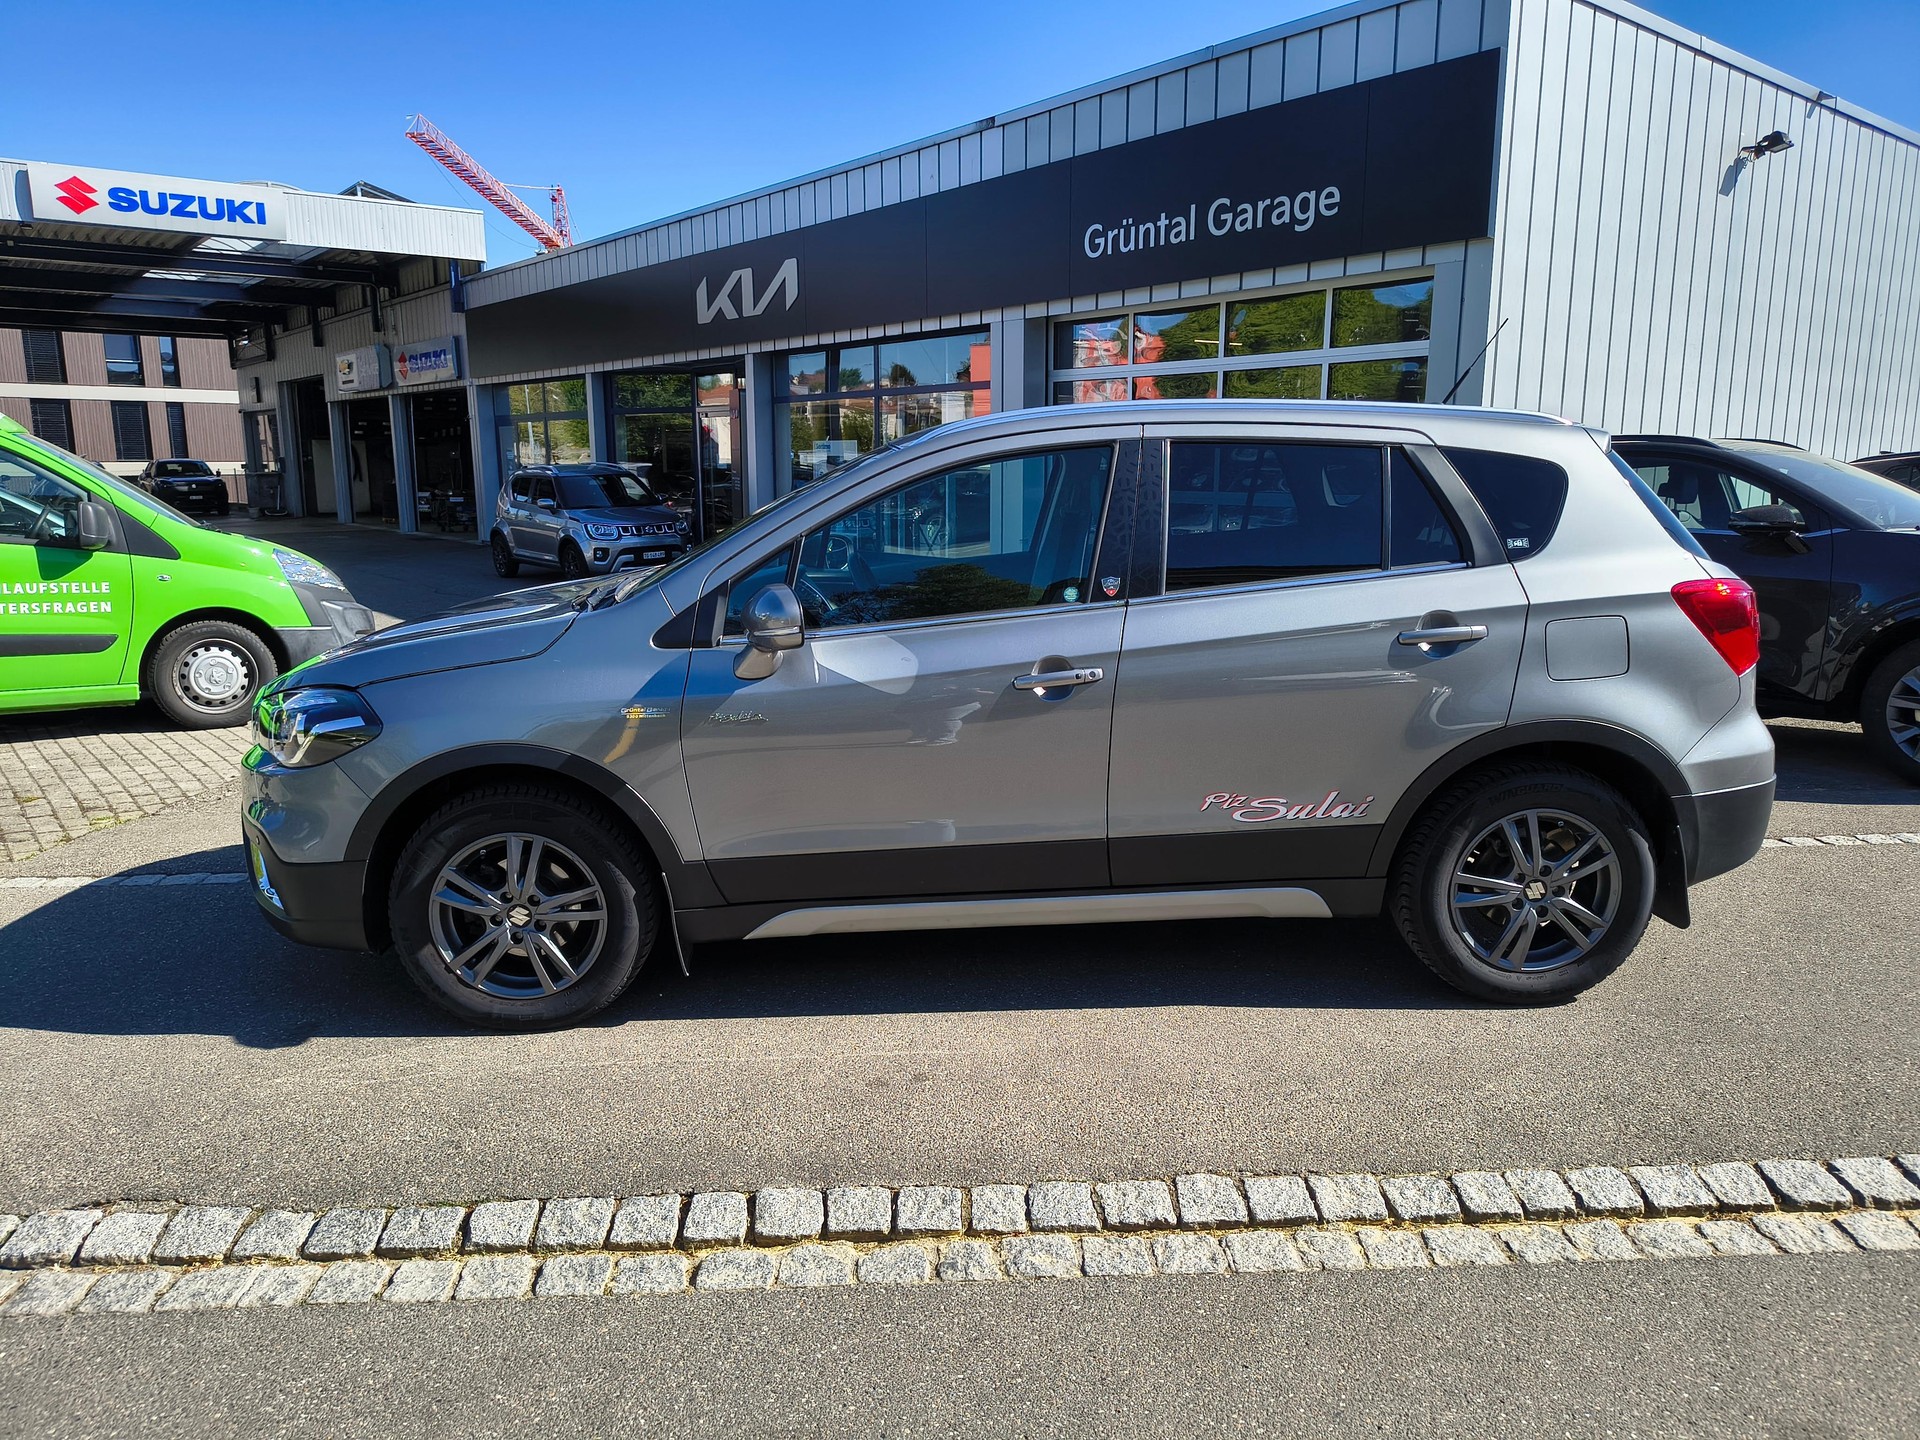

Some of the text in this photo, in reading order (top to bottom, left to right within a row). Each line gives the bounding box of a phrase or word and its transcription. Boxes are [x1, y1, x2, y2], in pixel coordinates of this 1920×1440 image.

[108, 187, 267, 225] SUZUKI
[1084, 186, 1341, 259] Grüntal Garage
[696, 257, 799, 325] KIA
[0, 582, 111, 595] LAUFSTELLE
[1199, 788, 1375, 823] Piz Sulai
